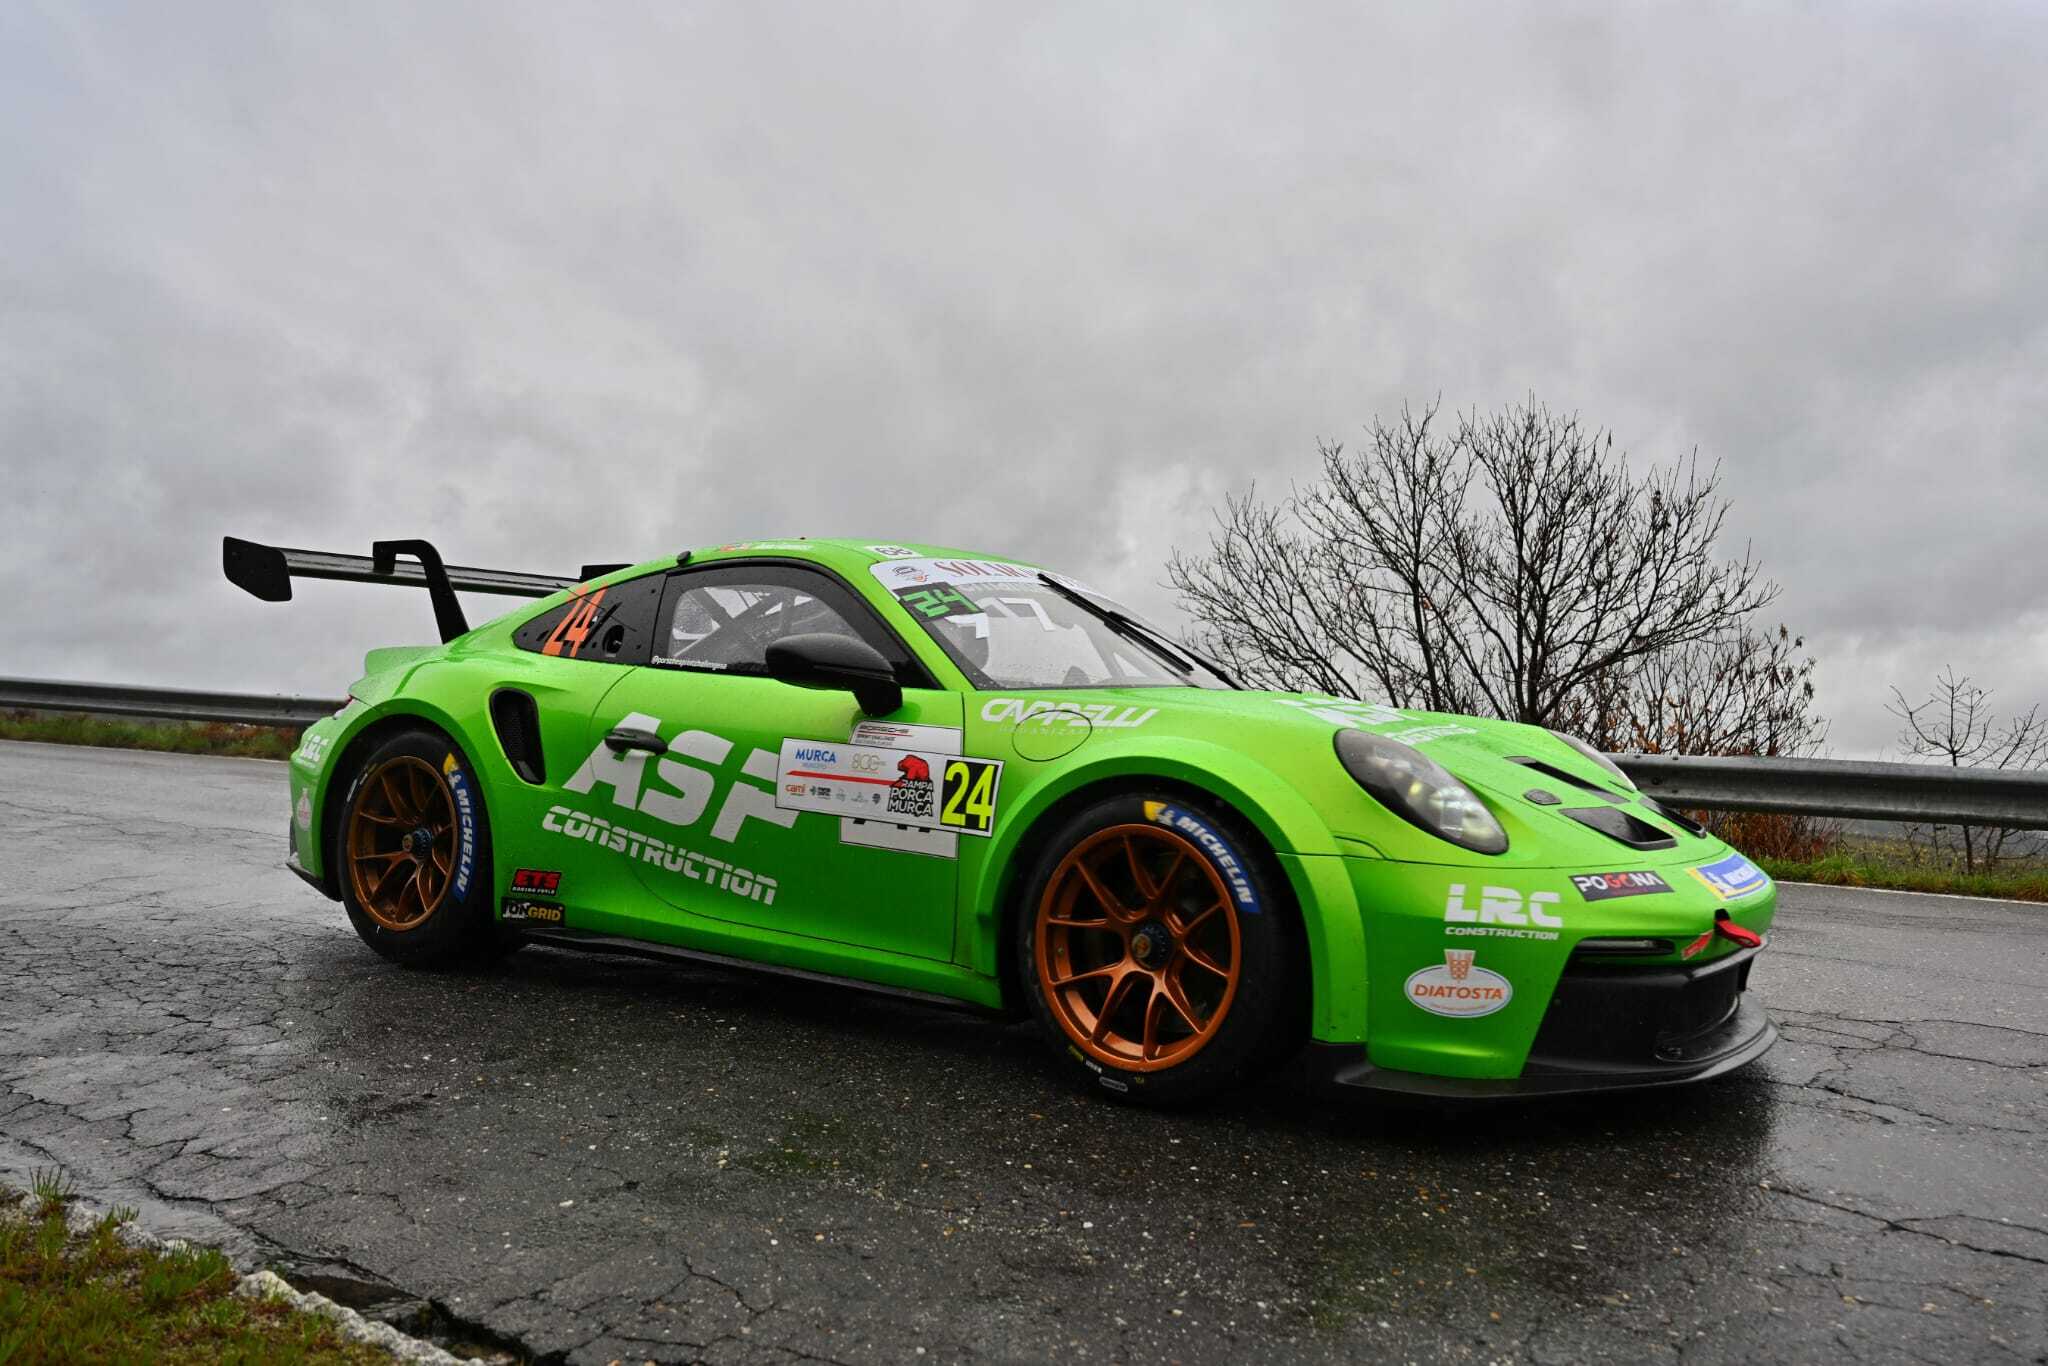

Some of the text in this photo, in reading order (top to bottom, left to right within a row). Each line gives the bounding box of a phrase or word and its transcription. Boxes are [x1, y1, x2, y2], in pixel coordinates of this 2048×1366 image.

[541, 580, 609, 658] 24
[902, 588, 979, 618] 24
[890, 787, 933, 803] PORCA
[941, 761, 996, 830] 24
[454, 788, 474, 892] MICHELIN
[541, 804, 778, 905] CONSTRUCTION
[1175, 815, 1255, 904] MICHELIN
[514, 869, 561, 889] ETS
[1443, 883, 1564, 928] LRC
[1413, 983, 1505, 1000] DIATOSTA
